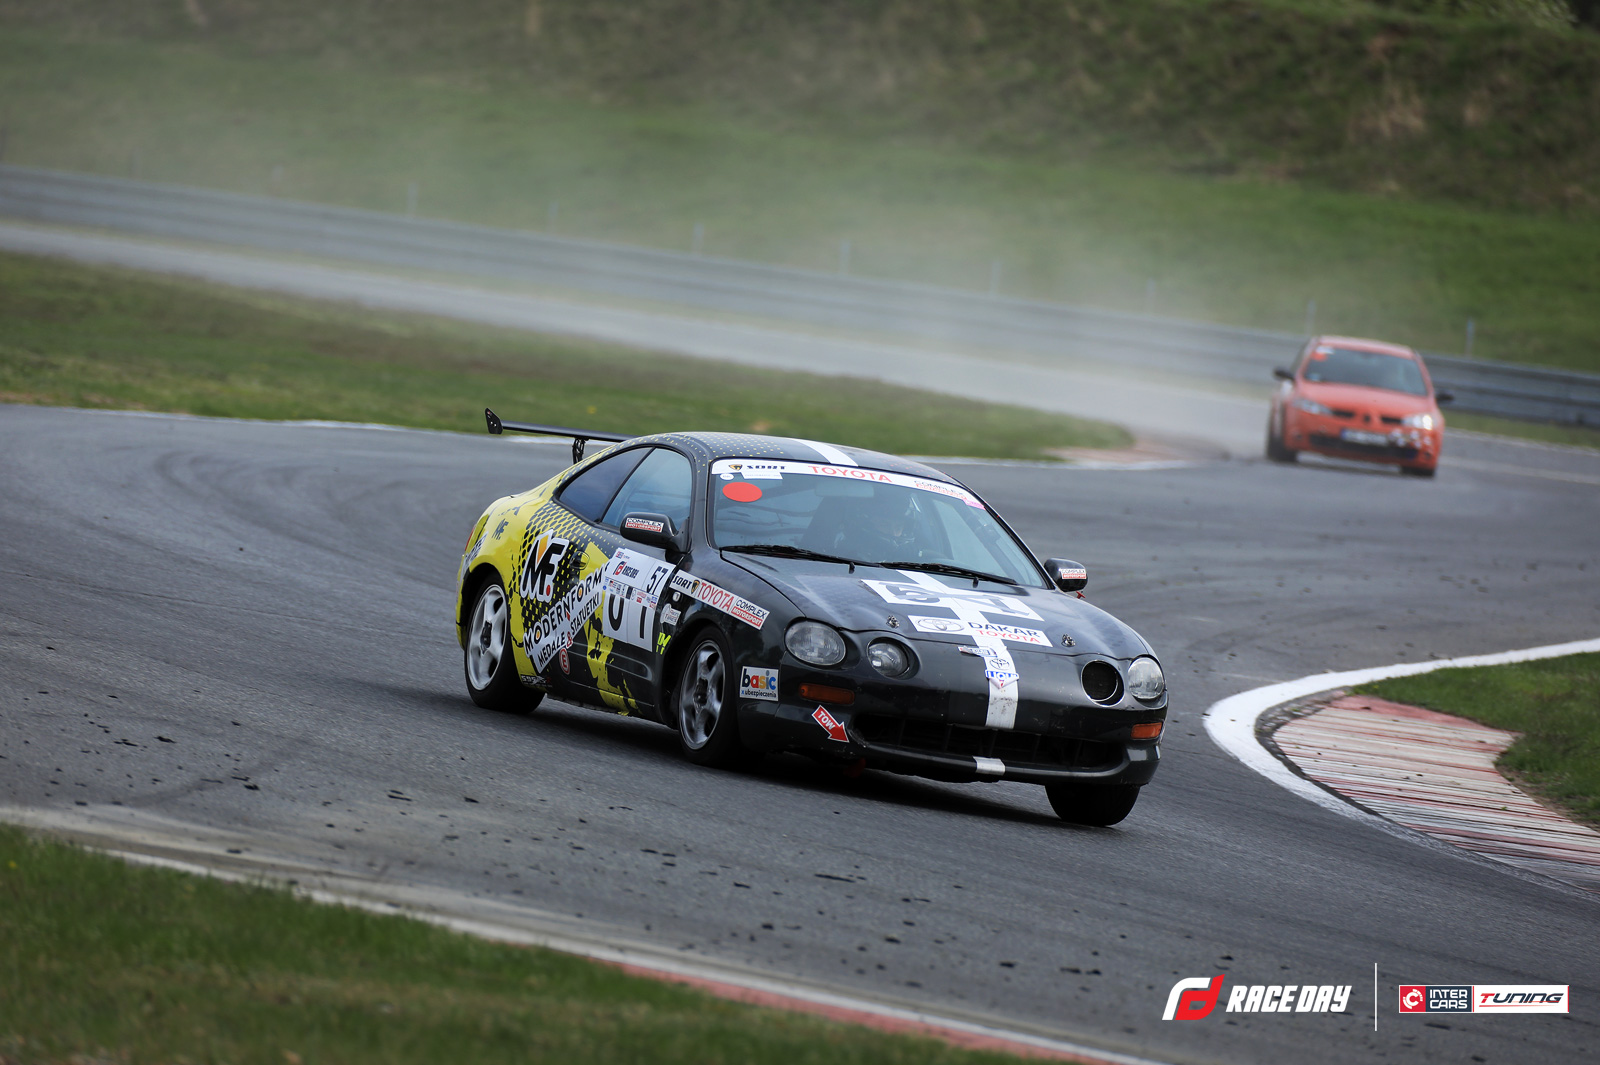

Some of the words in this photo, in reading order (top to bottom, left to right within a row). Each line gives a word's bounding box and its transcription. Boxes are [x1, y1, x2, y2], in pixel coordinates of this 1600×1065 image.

[808, 465, 892, 483] TOYOTA
[628, 518, 661, 527] COMPLEX
[647, 566, 669, 595] 57
[673, 575, 692, 590] SORT
[697, 582, 734, 611] TOYOTA
[733, 608, 762, 626] MOTORSPORT
[736, 599, 767, 619] COMPLEX
[538, 634, 566, 666] MEDALE
[566, 631, 573, 647] &
[570, 592, 600, 635] STATUETKI
[968, 621, 1040, 638] DAKAR
[978, 630, 1041, 643] TOYOTA
[742, 668, 776, 690] basic
[745, 690, 777, 698] ubezpieczenia
[818, 710, 836, 730] TOW
